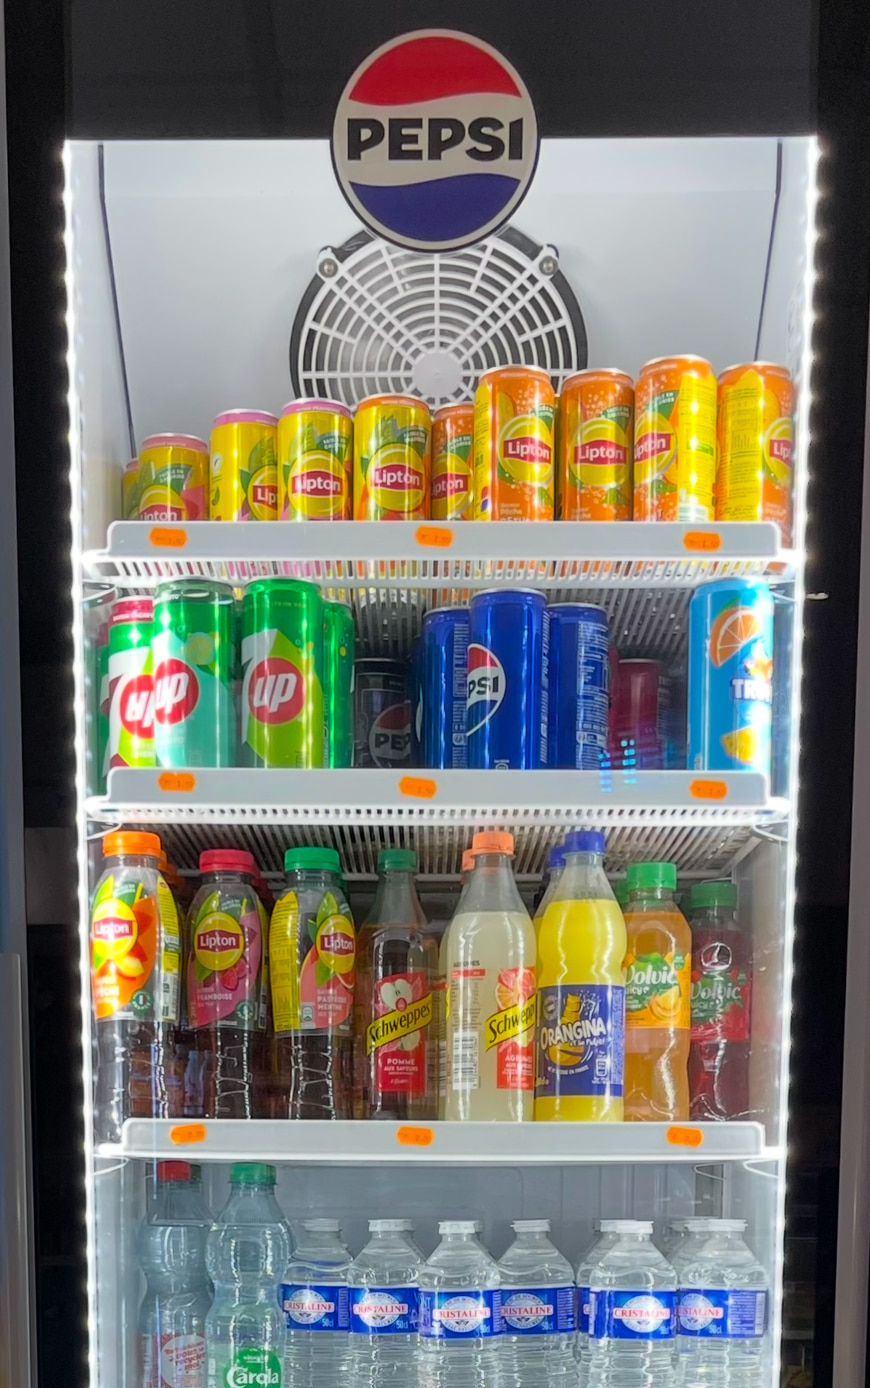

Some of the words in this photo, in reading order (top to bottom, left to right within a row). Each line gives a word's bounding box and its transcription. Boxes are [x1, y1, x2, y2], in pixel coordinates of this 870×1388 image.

[347, 117, 523, 162] PEPSI
[508, 441, 549, 461] Lipton
[579, 446, 623, 464] Lipton
[635, 437, 666, 459] ipton
[774, 442, 791, 459] Lip
[375, 466, 420, 487] Lipton
[257, 487, 277, 504] Lip
[296, 478, 341, 496] Lipton
[432, 478, 463, 497] ipton
[468, 676, 499, 698] PSI
[94, 921, 129, 937] Lipton
[200, 935, 236, 949] Lipton
[324, 936, 353, 951] Lipton
[369, 1003, 430, 1042] Schweppes
[489, 1003, 535, 1043] Schwepp
[541, 1017, 606, 1050] ORANGINA
[501, 1306, 552, 1316] RISTALINE
[227, 1366, 279, 1388] Carola
